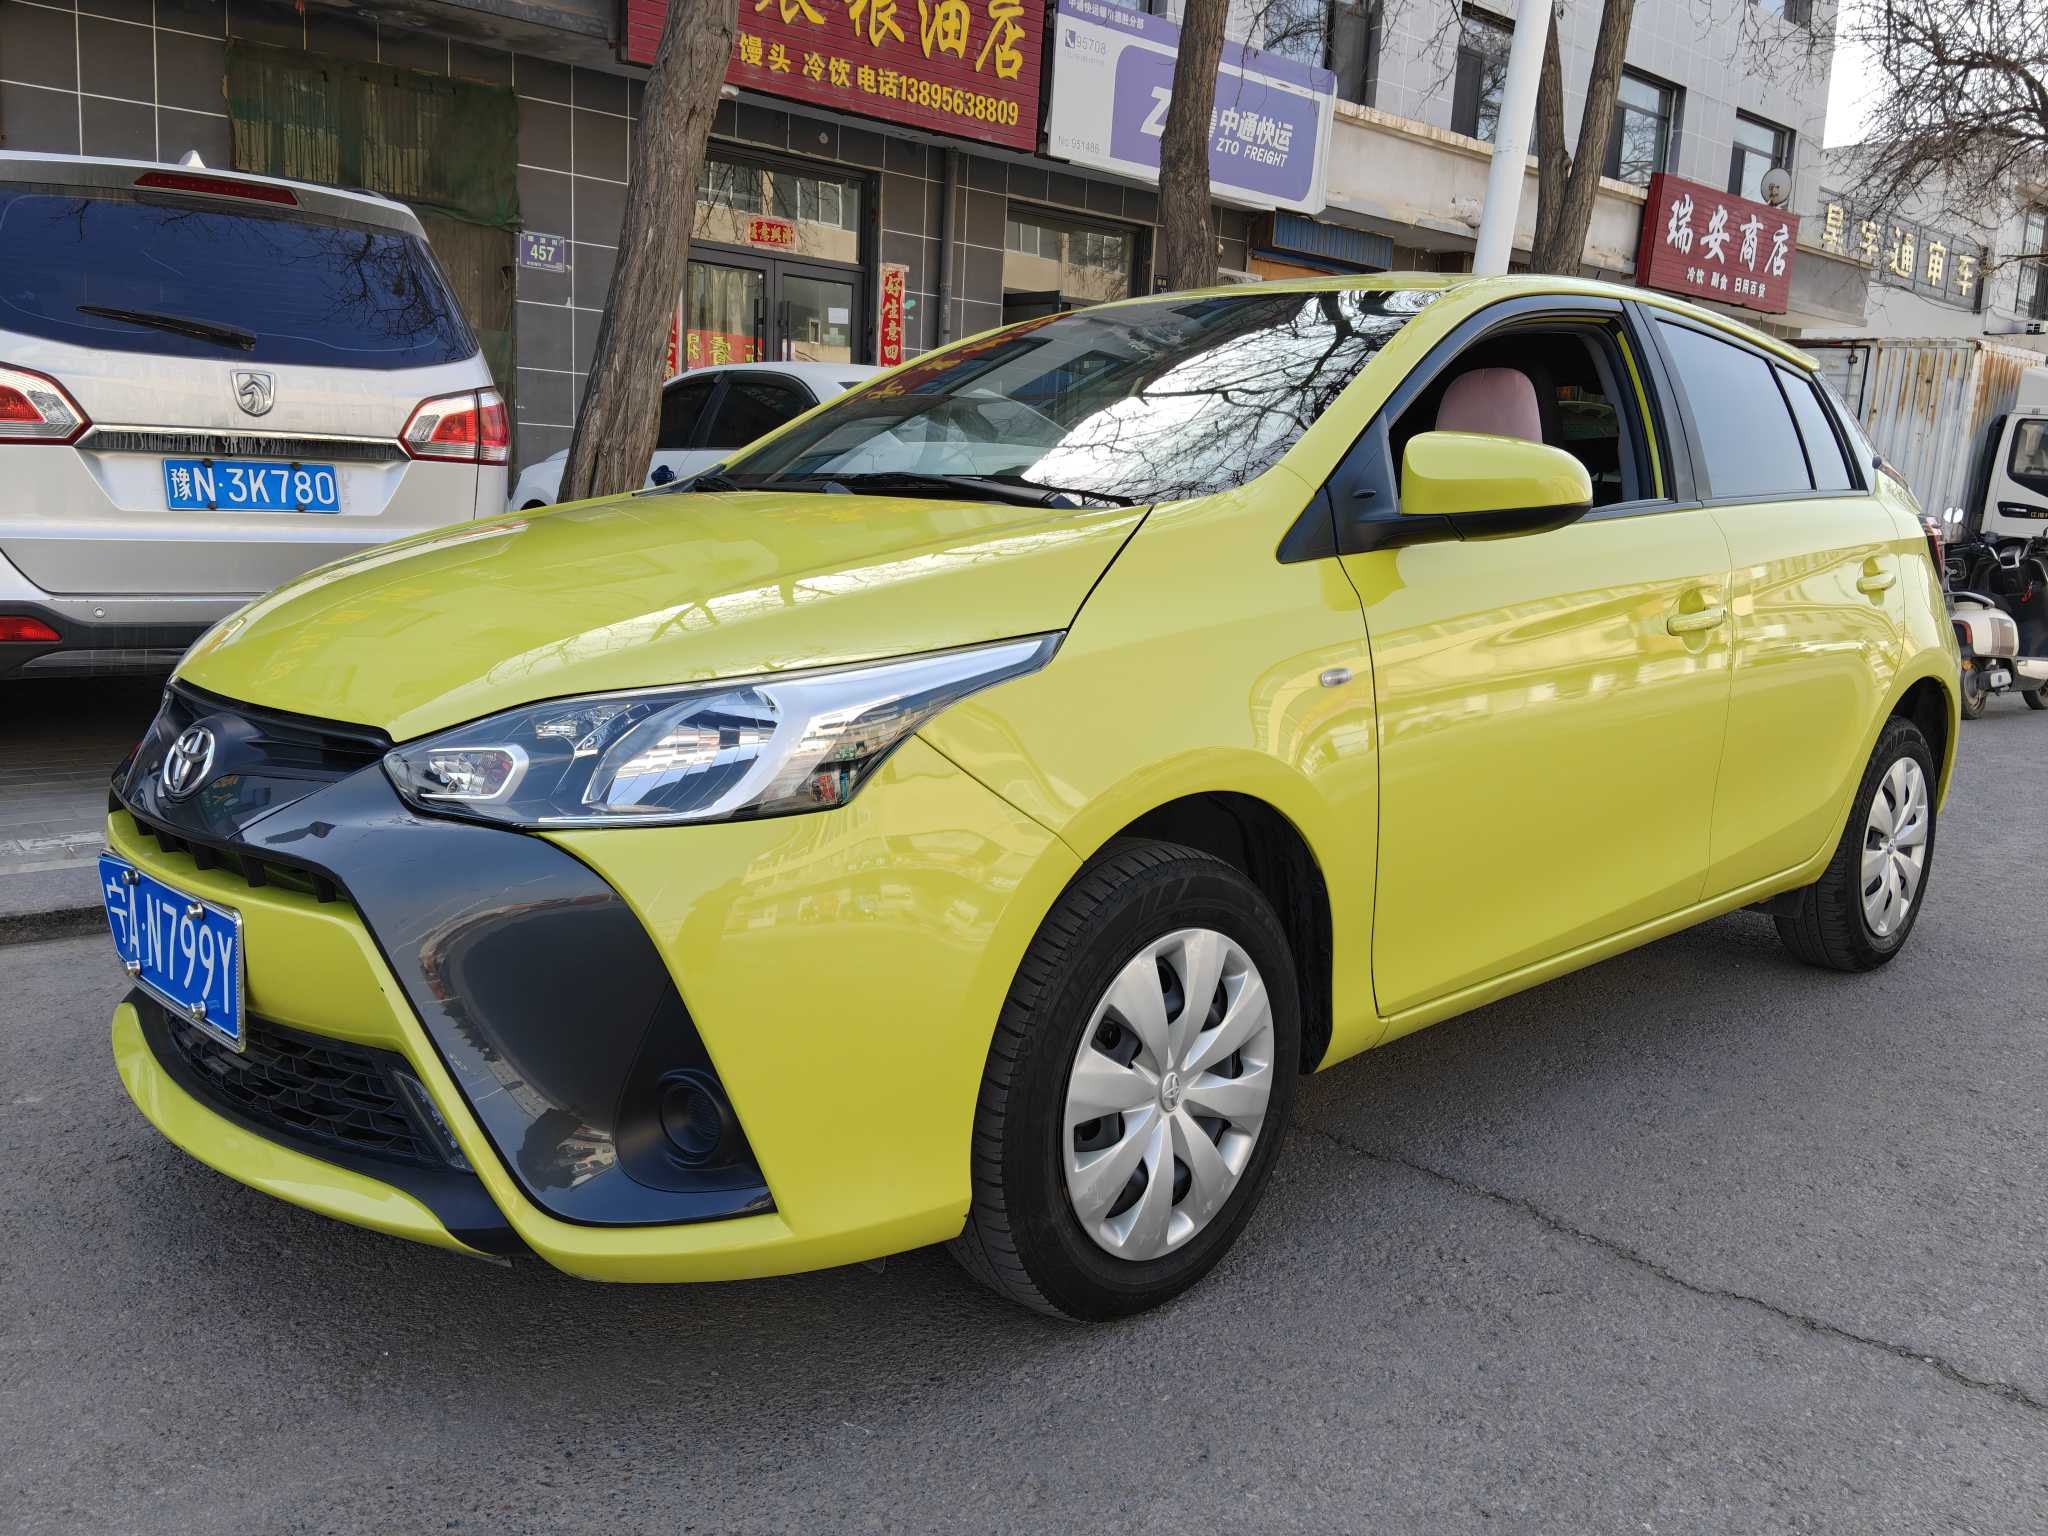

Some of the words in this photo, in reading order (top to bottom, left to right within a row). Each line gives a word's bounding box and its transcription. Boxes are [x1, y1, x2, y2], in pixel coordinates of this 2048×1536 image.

[739, 32, 792, 73] 馒头
[802, 51, 851, 88] 冷饮
[1076, 34, 1107, 57] 95708
[1219, 106, 1294, 152] 中通快运
[1216, 138, 1239, 155] ZTO
[1243, 144, 1289, 168] FREIGHT
[1667, 193, 1790, 277] 瑞安商店
[530, 243, 556, 262] 457
[1686, 266, 1705, 287] 冷饮
[1710, 271, 1729, 291] 副食
